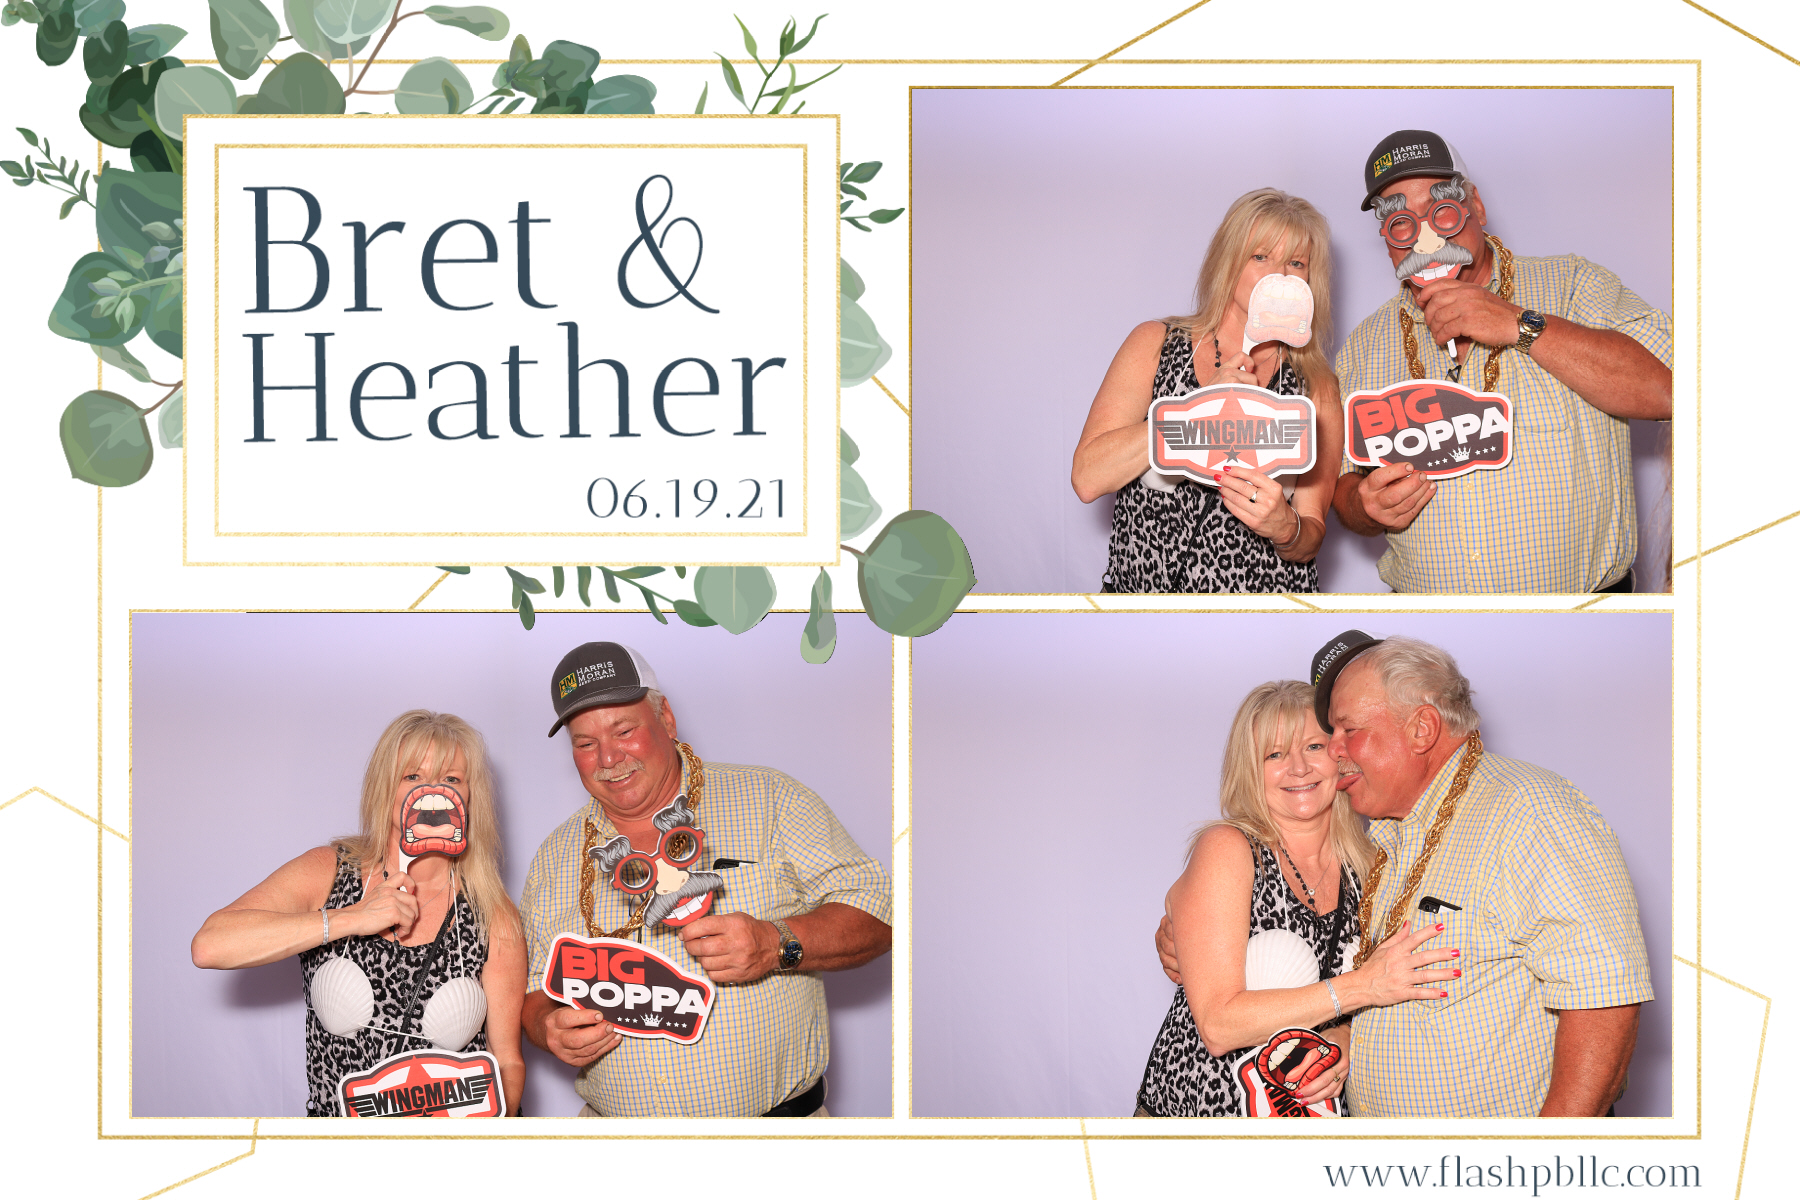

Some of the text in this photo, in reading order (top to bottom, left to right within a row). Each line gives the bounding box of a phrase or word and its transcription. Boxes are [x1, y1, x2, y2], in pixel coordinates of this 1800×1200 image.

[1392, 143, 1429, 155] HARRIS
[1393, 149, 1430, 162] MORAN
[1354, 387, 1444, 440] BIG
[1181, 419, 1284, 445] WINGMAN
[1363, 406, 1509, 464] POPPA
[576, 661, 614, 677] HARRIS
[1317, 641, 1344, 674] HARRIS
[1325, 644, 1349, 667] ORAN
[578, 667, 616, 683] MORAN
[561, 946, 645, 984] BIG
[562, 978, 708, 1015] POPPA
[373, 1077, 473, 1116] WINGMAN
